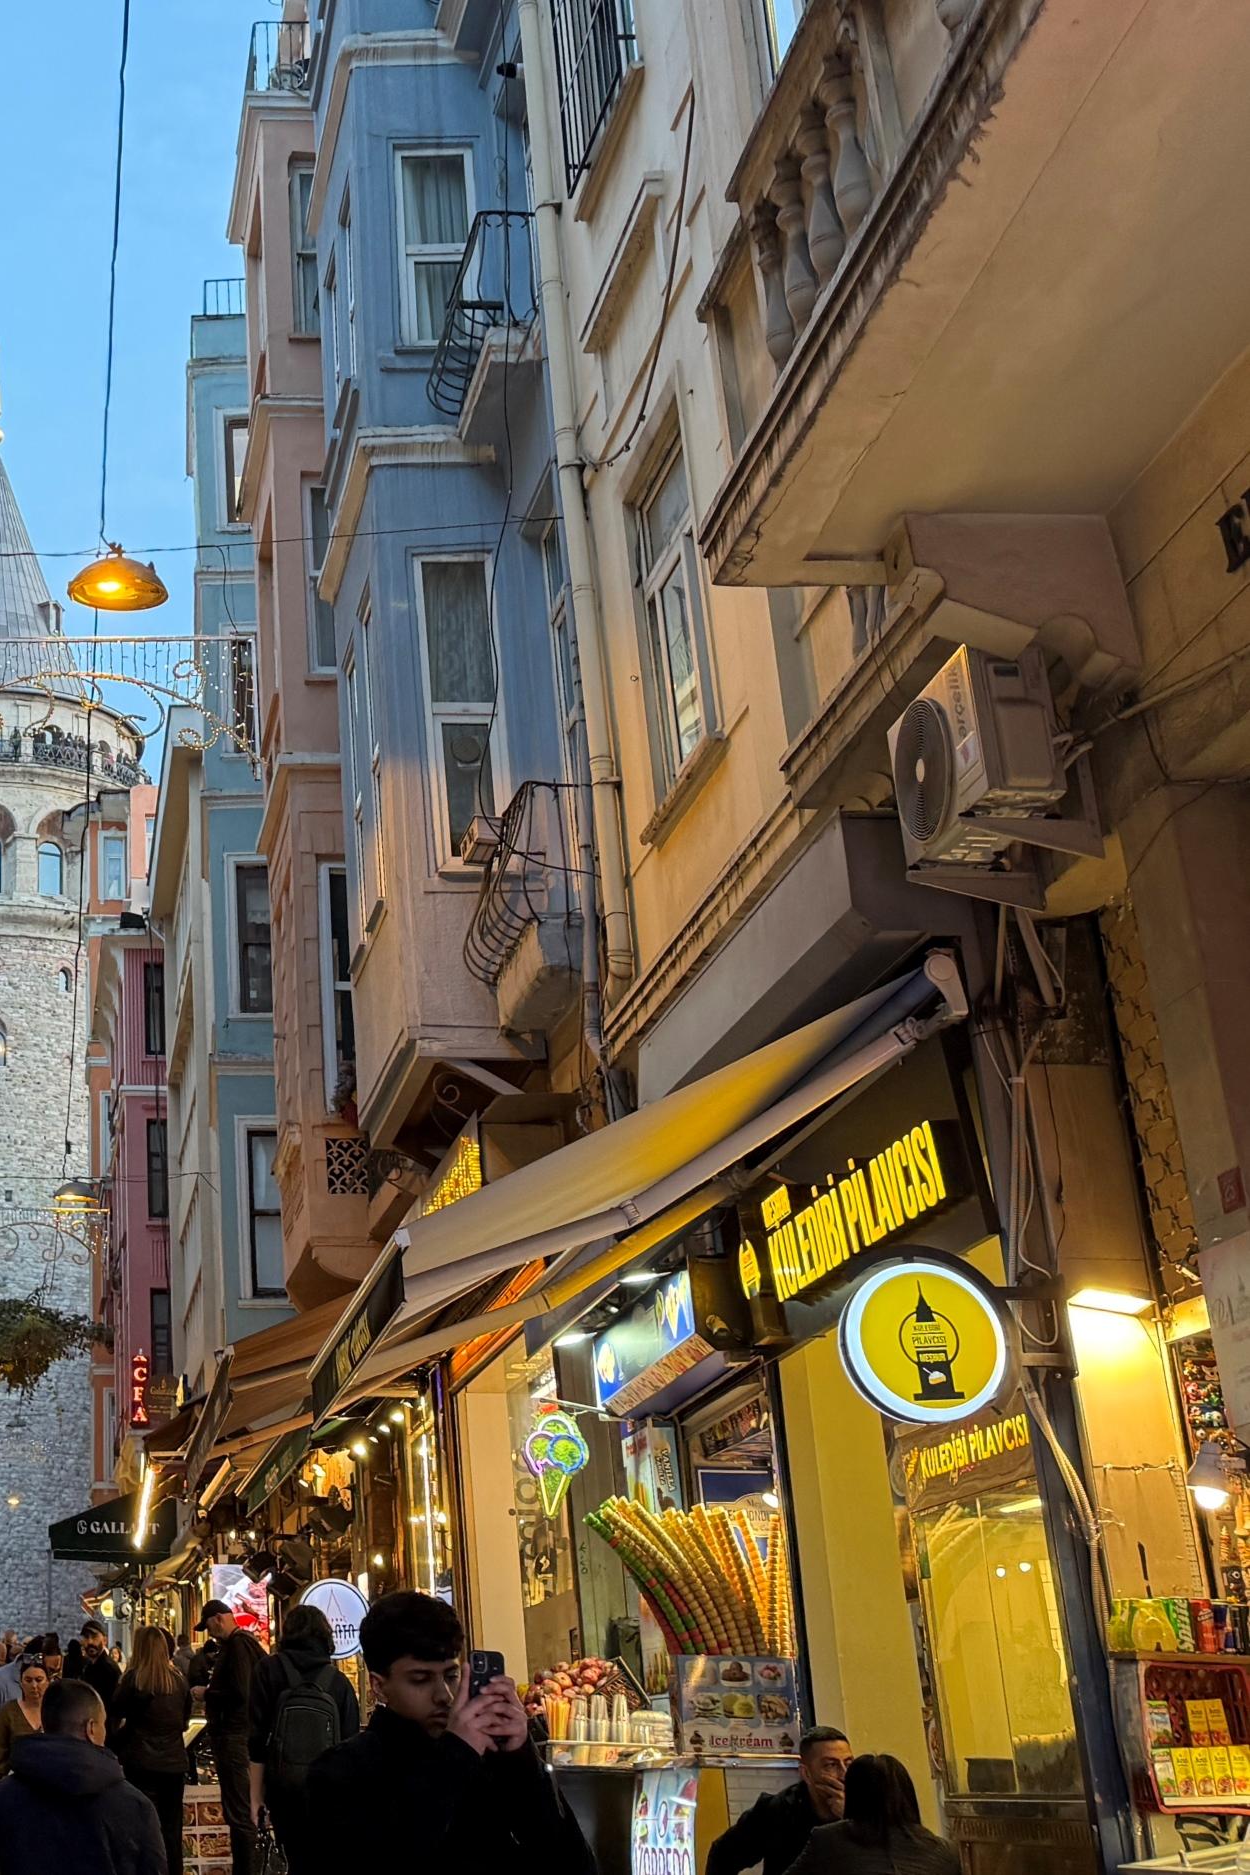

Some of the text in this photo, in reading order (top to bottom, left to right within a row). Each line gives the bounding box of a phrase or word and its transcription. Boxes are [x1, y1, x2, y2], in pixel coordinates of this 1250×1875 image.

[768, 1119, 947, 1302] KULEDİBİ PİLAVCISI
[968, 1413, 1030, 1463] PİLAVCISI
[90, 1521, 160, 1535] GALLT
